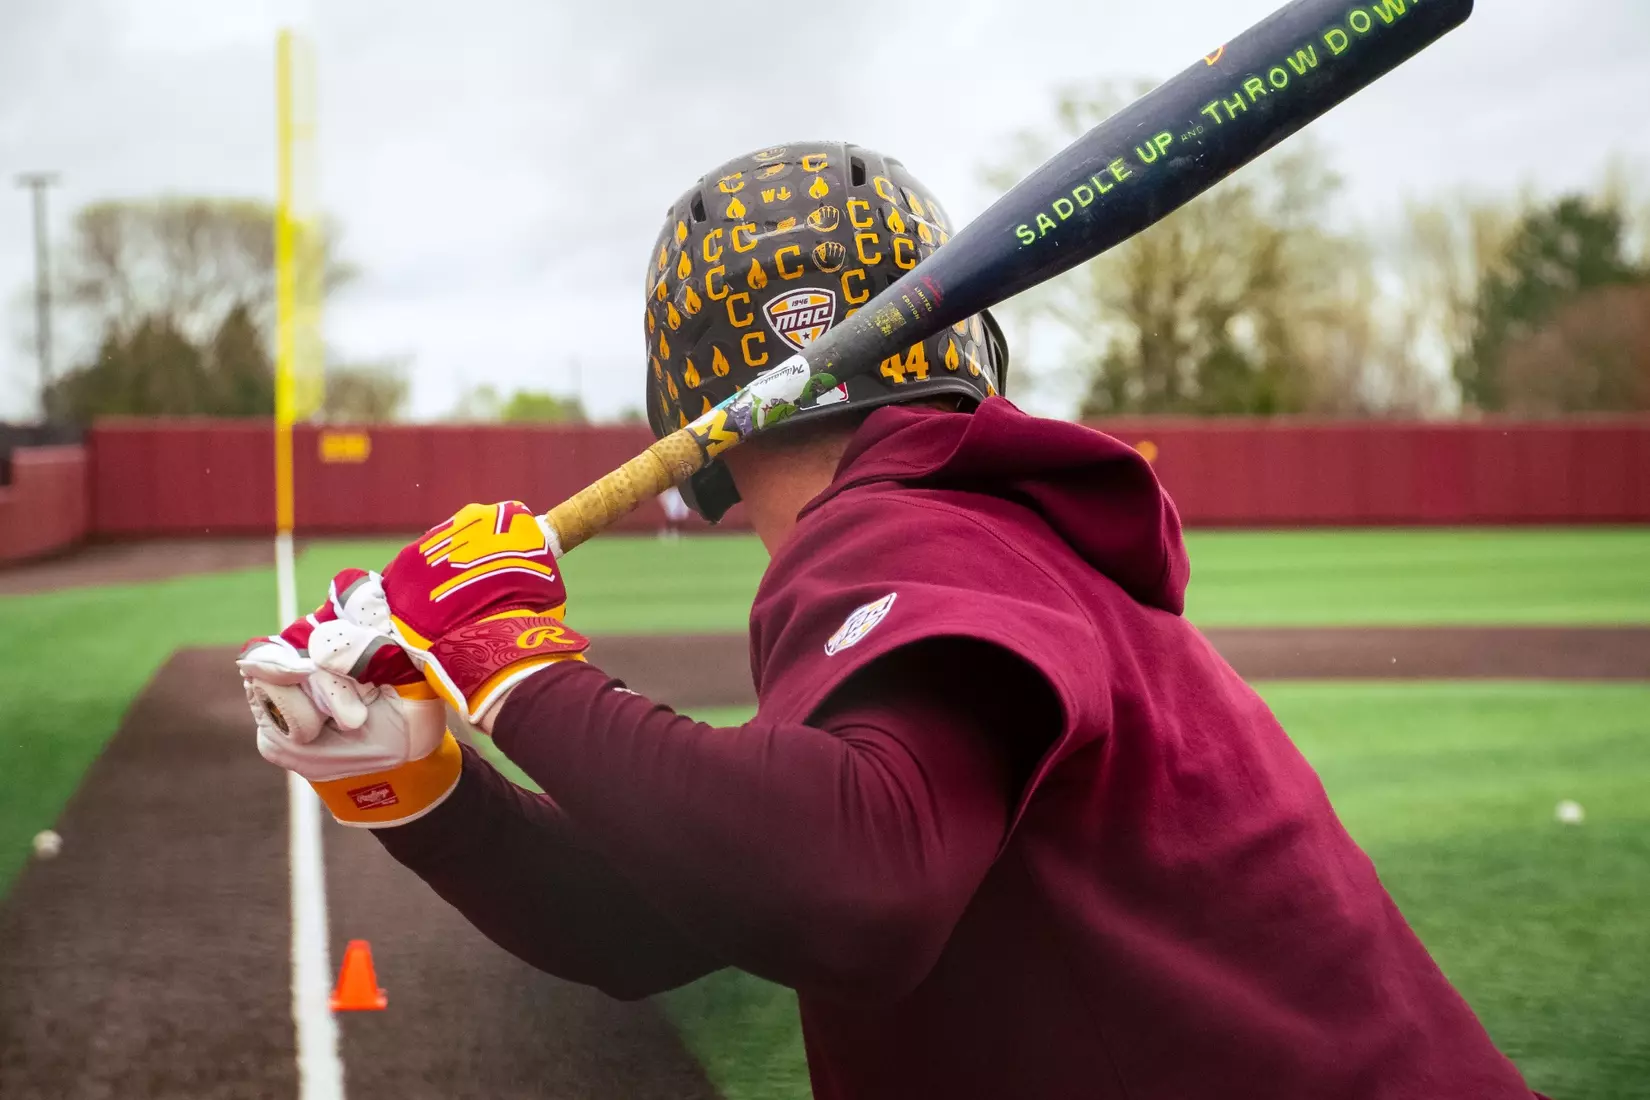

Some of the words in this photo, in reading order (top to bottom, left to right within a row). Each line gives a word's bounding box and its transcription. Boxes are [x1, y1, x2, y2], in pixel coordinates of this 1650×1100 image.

[1016, 157, 1133, 245] SADDLE
[1136, 131, 1173, 163] UP
[1180, 125, 1204, 142] AND
[1201, 44, 1318, 124] THROW
[1323, 0, 1419, 55] DOW
[846, 200, 874, 228] C
[703, 228, 723, 262] C
[731, 222, 758, 253] C
[855, 233, 882, 265] C
[893, 237, 916, 270] C
[774, 244, 805, 281] C
[705, 265, 729, 301] C
[841, 268, 870, 305] C
[725, 292, 754, 328] C
[775, 306, 832, 331] MAC
[791, 298, 809, 307] 1946
[902, 294, 920, 320] EDITION
[741, 331, 769, 367] C
[880, 340, 929, 384] 44
